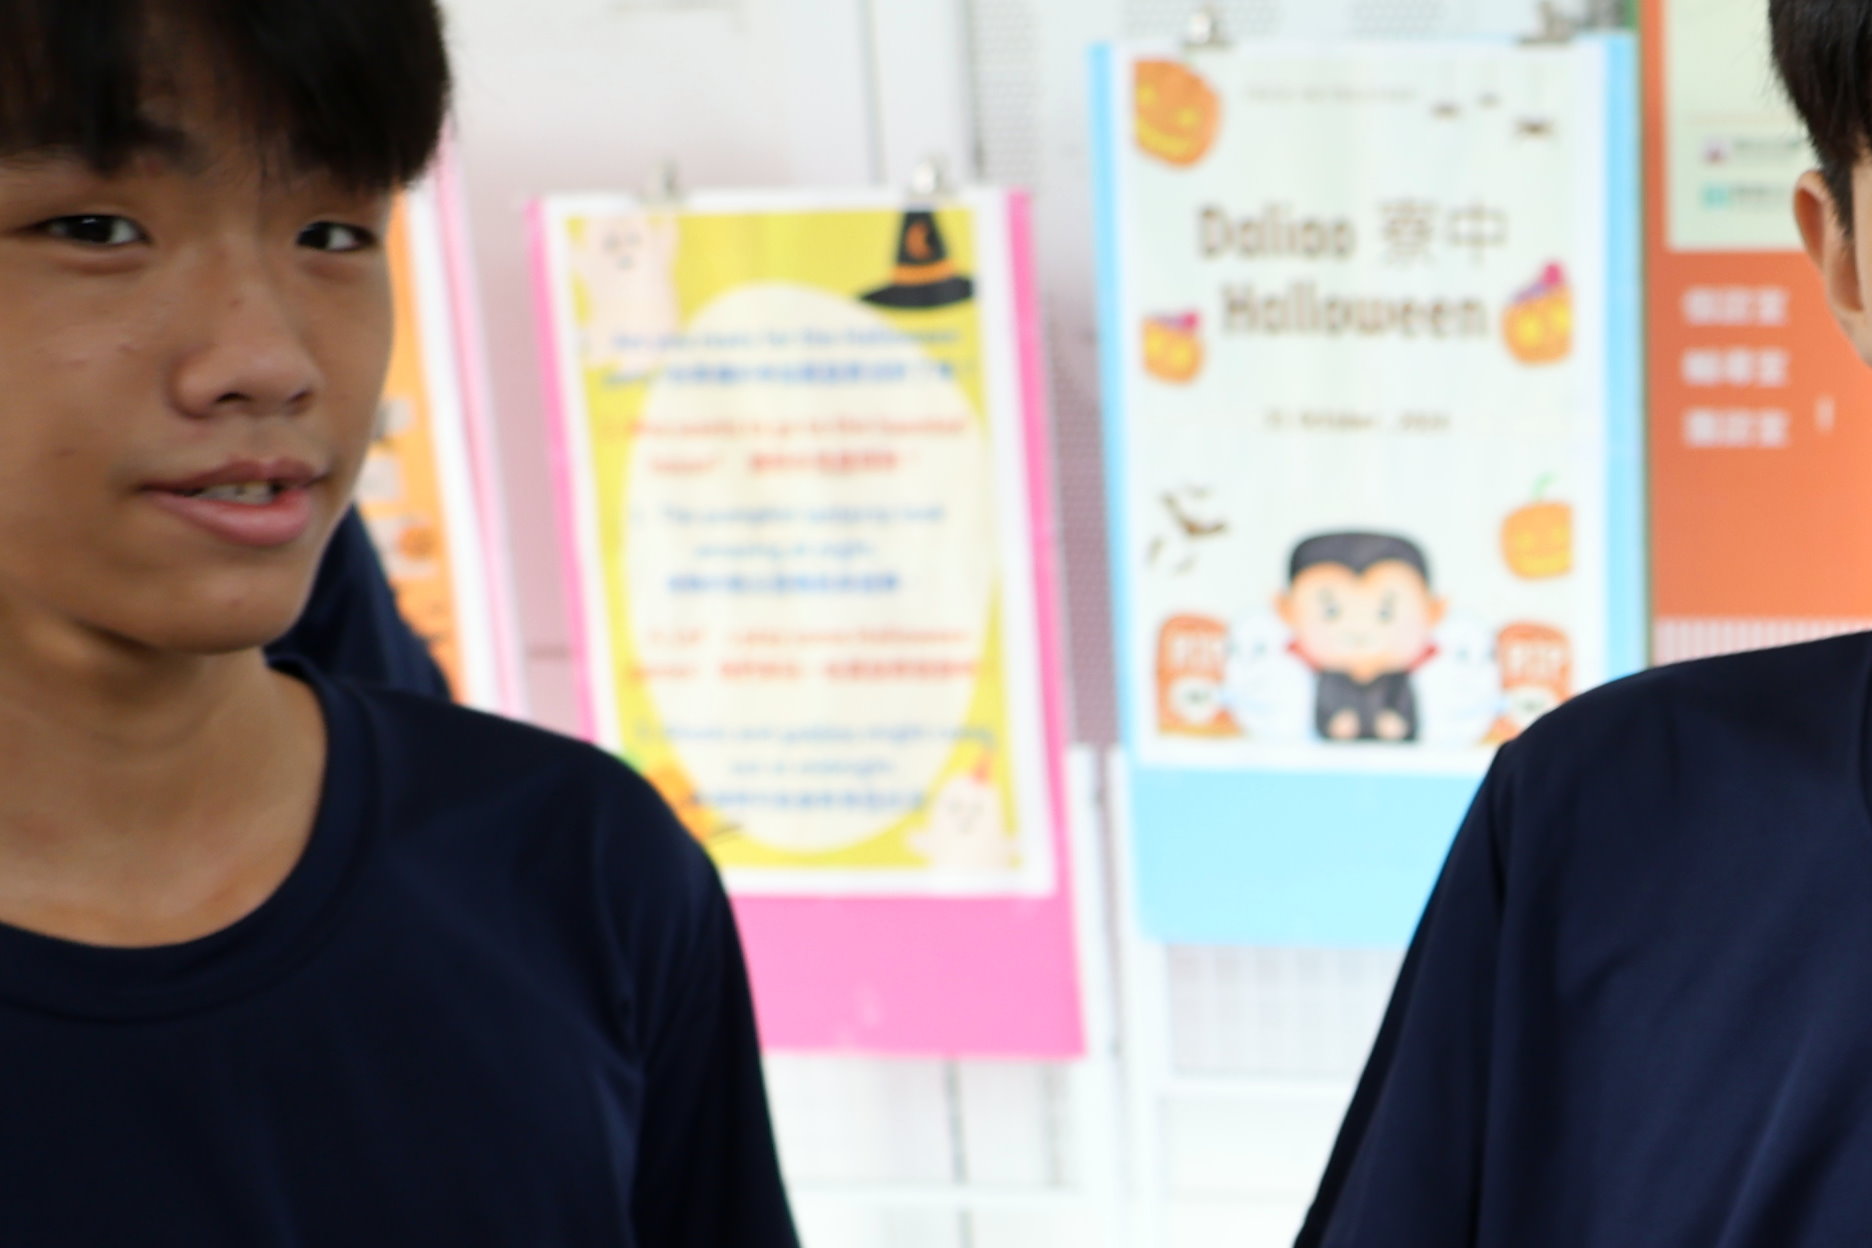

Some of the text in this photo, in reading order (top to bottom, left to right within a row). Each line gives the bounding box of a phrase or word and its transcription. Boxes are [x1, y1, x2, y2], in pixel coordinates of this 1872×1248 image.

[1196, 196, 1509, 268] Daliao 寮中
[1220, 281, 1490, 338] Halloween
